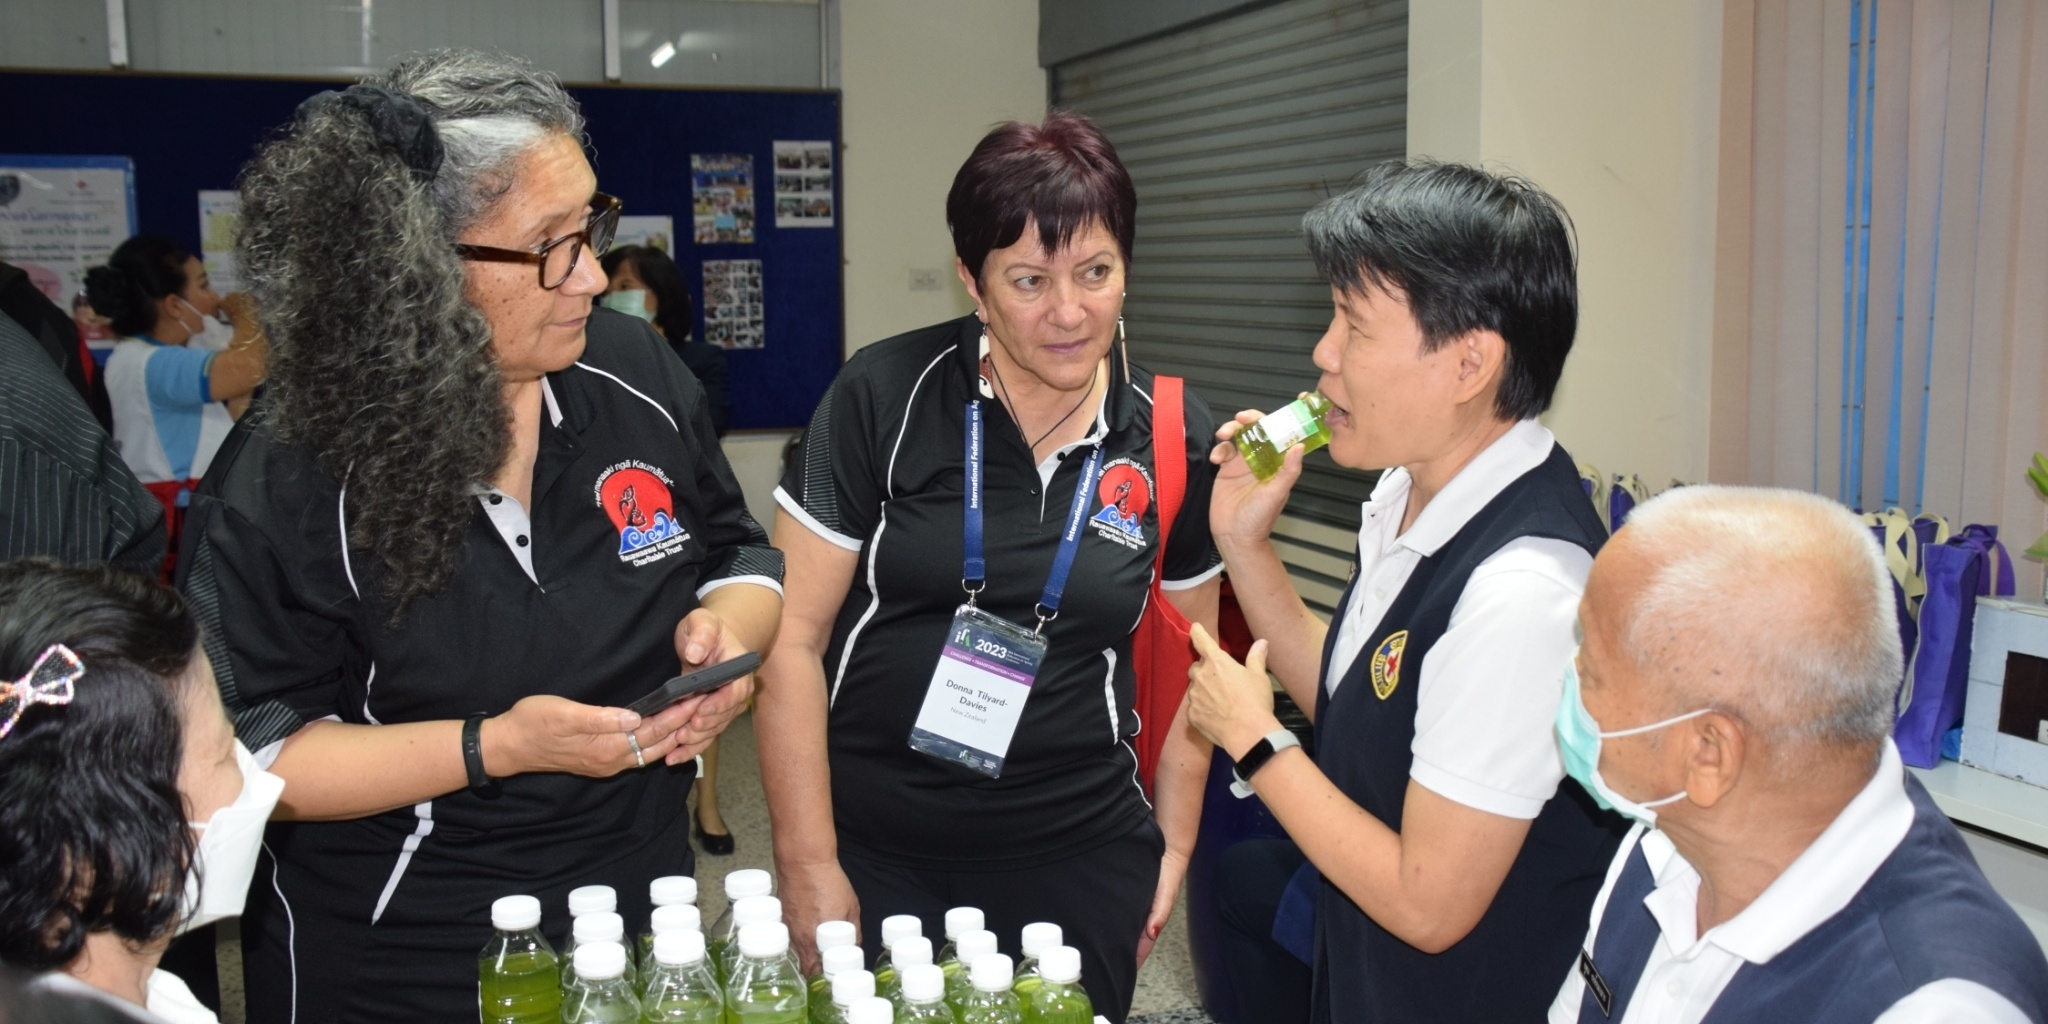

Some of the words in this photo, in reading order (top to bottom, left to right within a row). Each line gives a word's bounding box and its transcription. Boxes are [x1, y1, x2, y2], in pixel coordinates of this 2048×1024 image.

[972, 411, 979, 421] on
[970, 422, 979, 460] Federation
[970, 461, 979, 509] International
[1066, 493, 1087, 542] International
[1080, 458, 1097, 497] Federation
[1091, 449, 1099, 459] on
[1098, 529, 1126, 546] Charitable
[1125, 537, 1138, 550] Trust
[632, 552, 666, 567] Charitable
[665, 544, 684, 557] Trust
[974, 638, 1008, 659] 2023
[946, 679, 973, 696] Donna
[977, 690, 1008, 707] Tilyard-
[950, 706, 964, 716] New
[964, 711, 987, 724] Zealand
[959, 696, 987, 713] Davies
